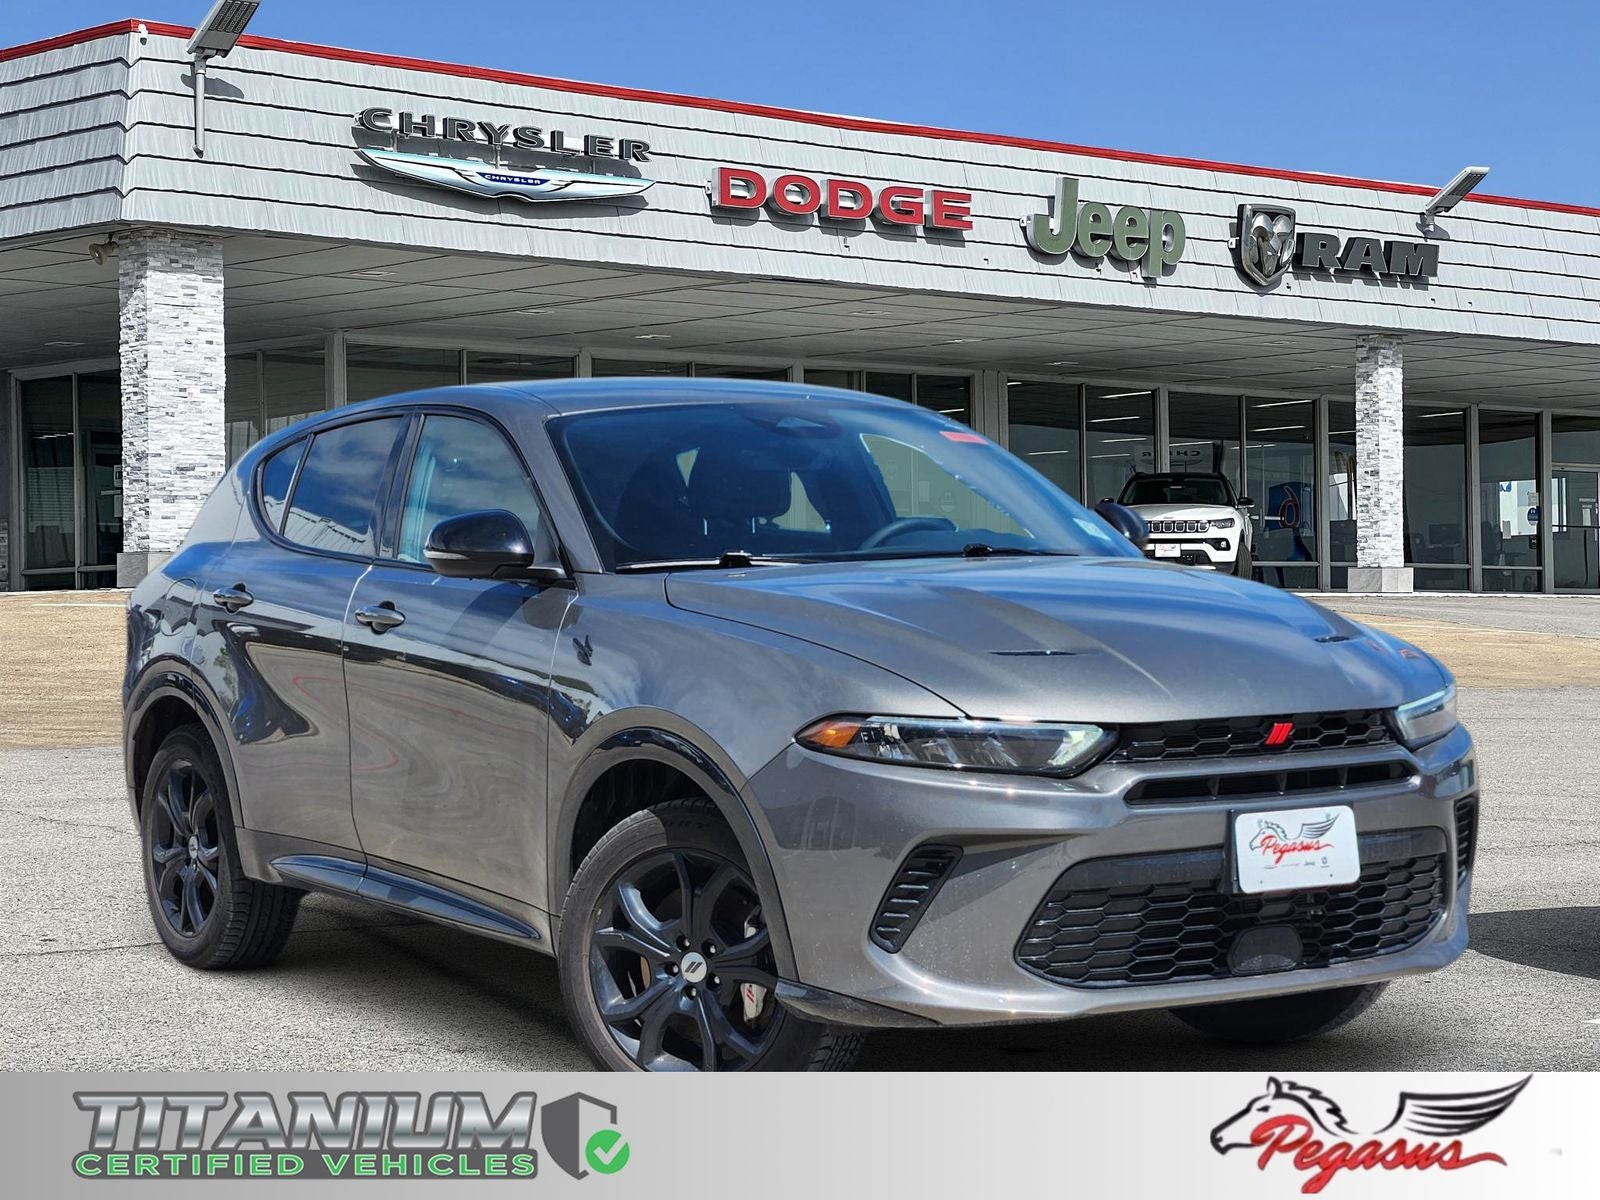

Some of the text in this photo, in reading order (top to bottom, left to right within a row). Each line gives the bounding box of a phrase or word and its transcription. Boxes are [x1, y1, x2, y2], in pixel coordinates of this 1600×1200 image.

[358, 106, 651, 162] CHRYSLER
[484, 174, 541, 185] CHRYSLER
[713, 166, 974, 231] DODGE
[1027, 176, 1187, 278] Jeep
[1298, 231, 1440, 277] RAM
[1260, 834, 1334, 864] Pegasus
